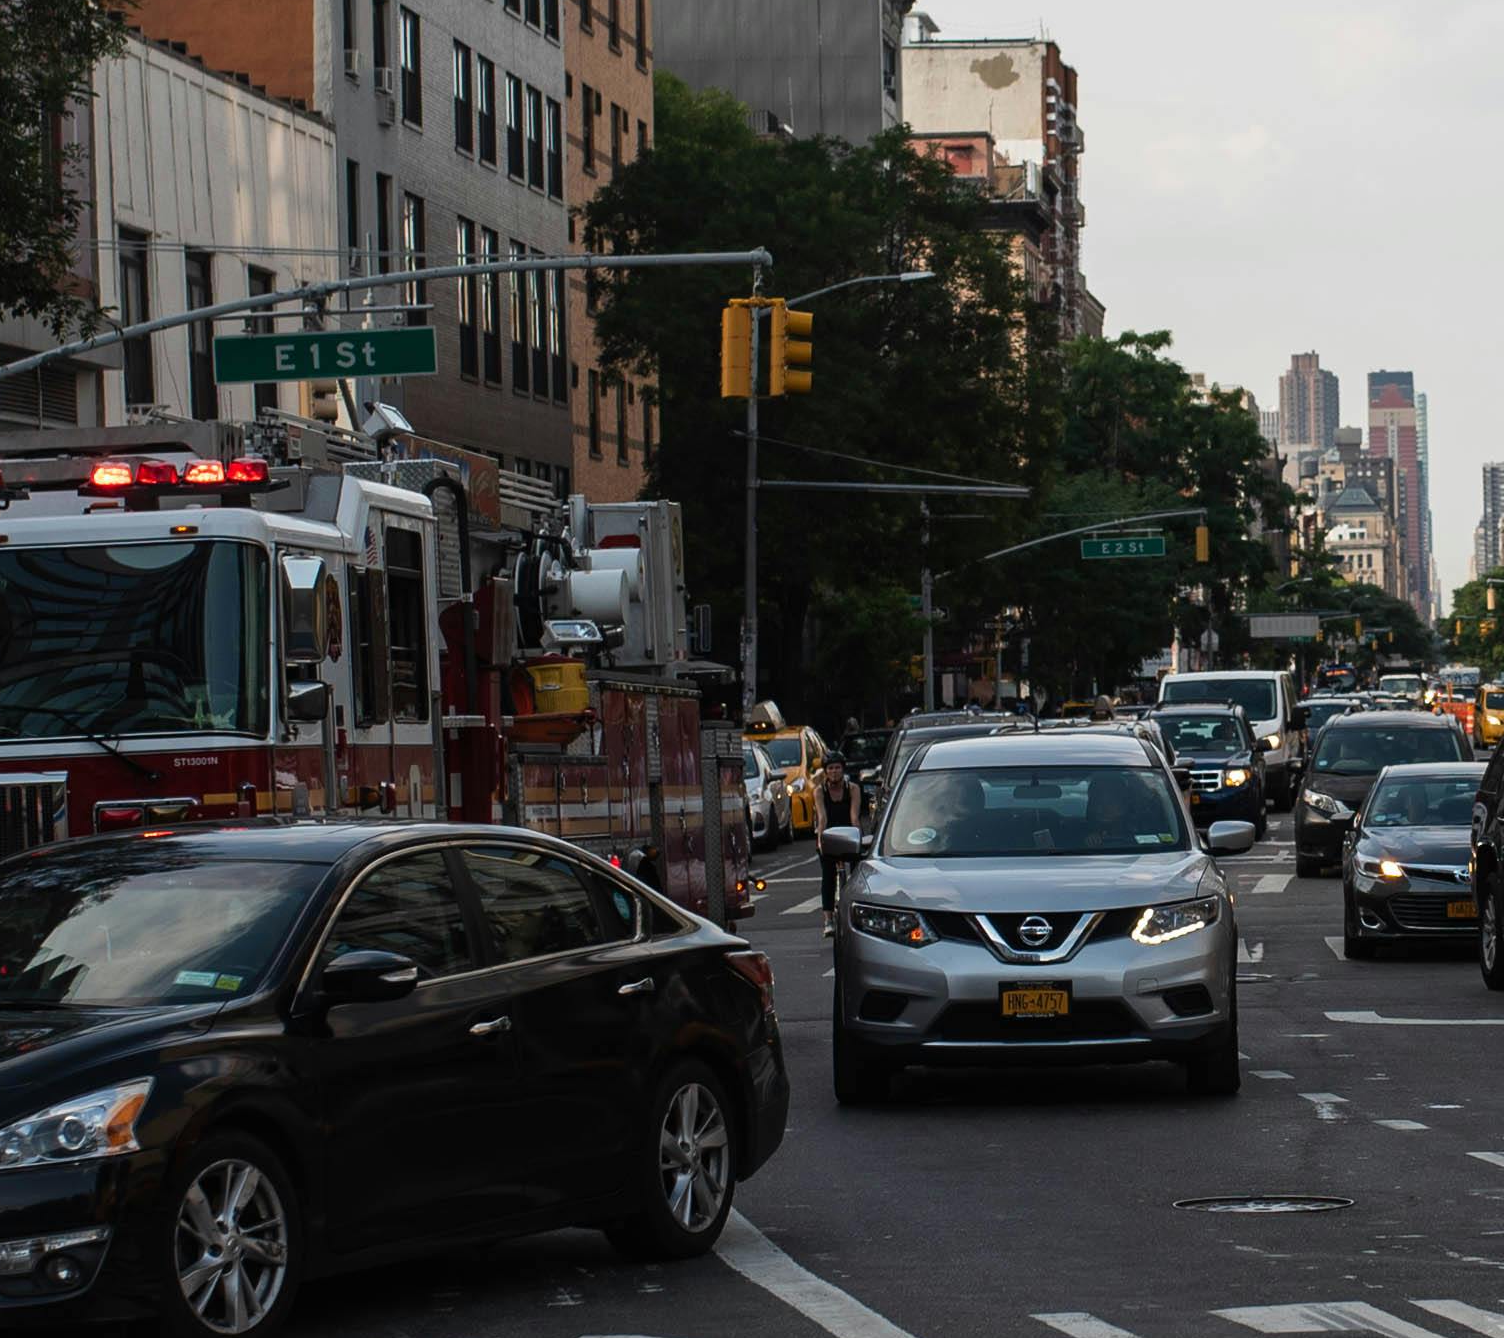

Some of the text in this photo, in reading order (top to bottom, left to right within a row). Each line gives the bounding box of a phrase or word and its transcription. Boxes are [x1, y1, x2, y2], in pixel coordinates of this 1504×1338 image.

[275, 341, 376, 371] E 1 St
[1101, 542, 1145, 554] E 2 St
